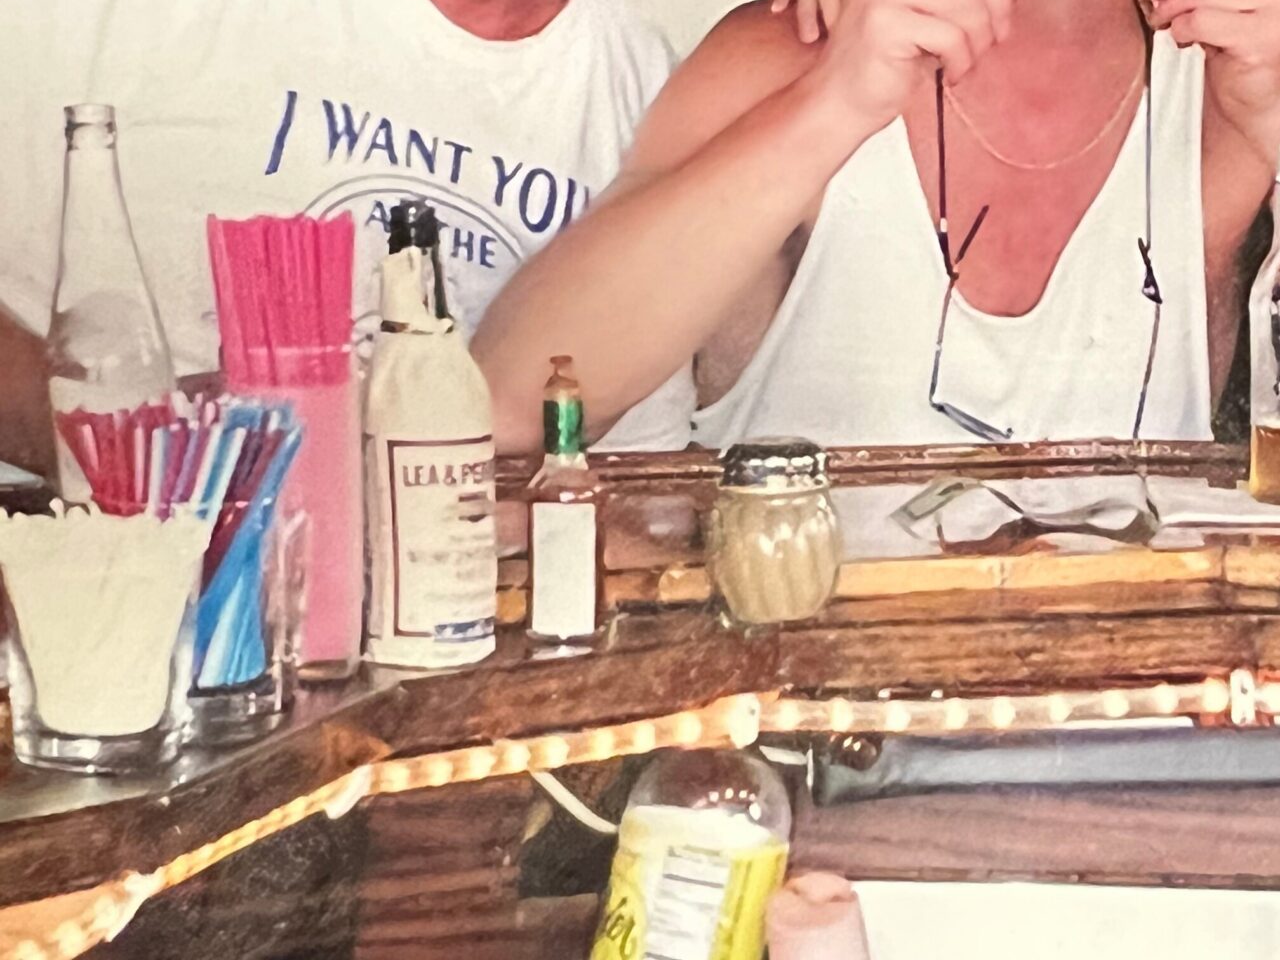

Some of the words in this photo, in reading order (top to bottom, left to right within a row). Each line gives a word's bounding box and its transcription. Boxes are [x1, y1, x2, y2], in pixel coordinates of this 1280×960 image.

[264, 90, 298, 176] I
[322, 98, 473, 184] WANT
[437, 217, 498, 269] HE
[402, 464, 440, 487] LEA
